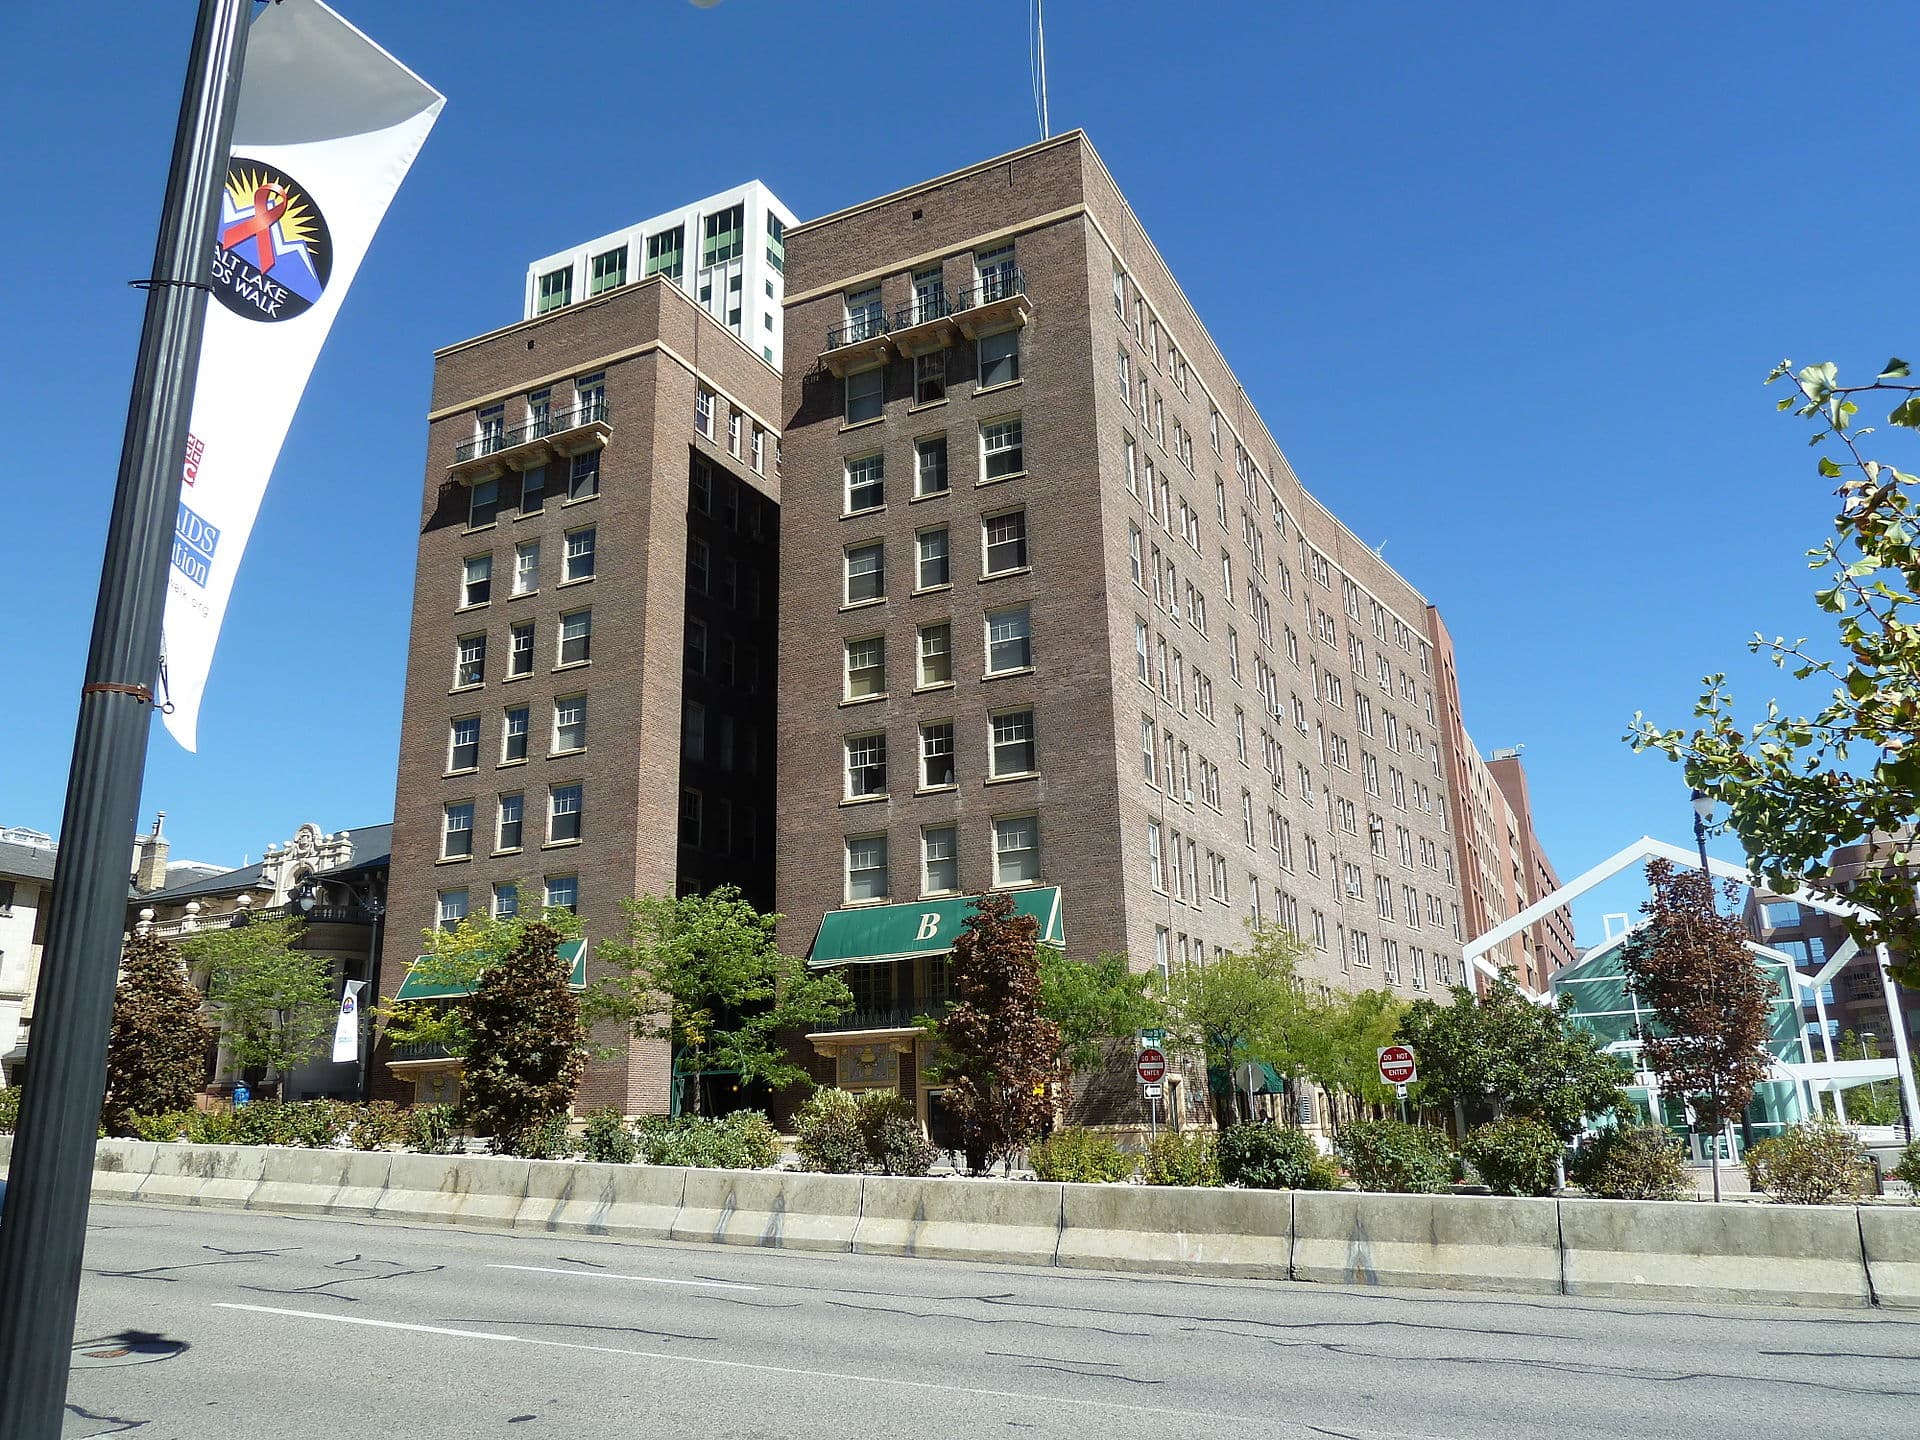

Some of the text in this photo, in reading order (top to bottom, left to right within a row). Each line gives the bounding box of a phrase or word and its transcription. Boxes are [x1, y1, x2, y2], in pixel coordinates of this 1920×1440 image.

[236, 277, 281, 318] WALK
[241, 266, 288, 304] LAKE
[177, 509, 216, 552] IDS
[912, 912, 941, 941] B
